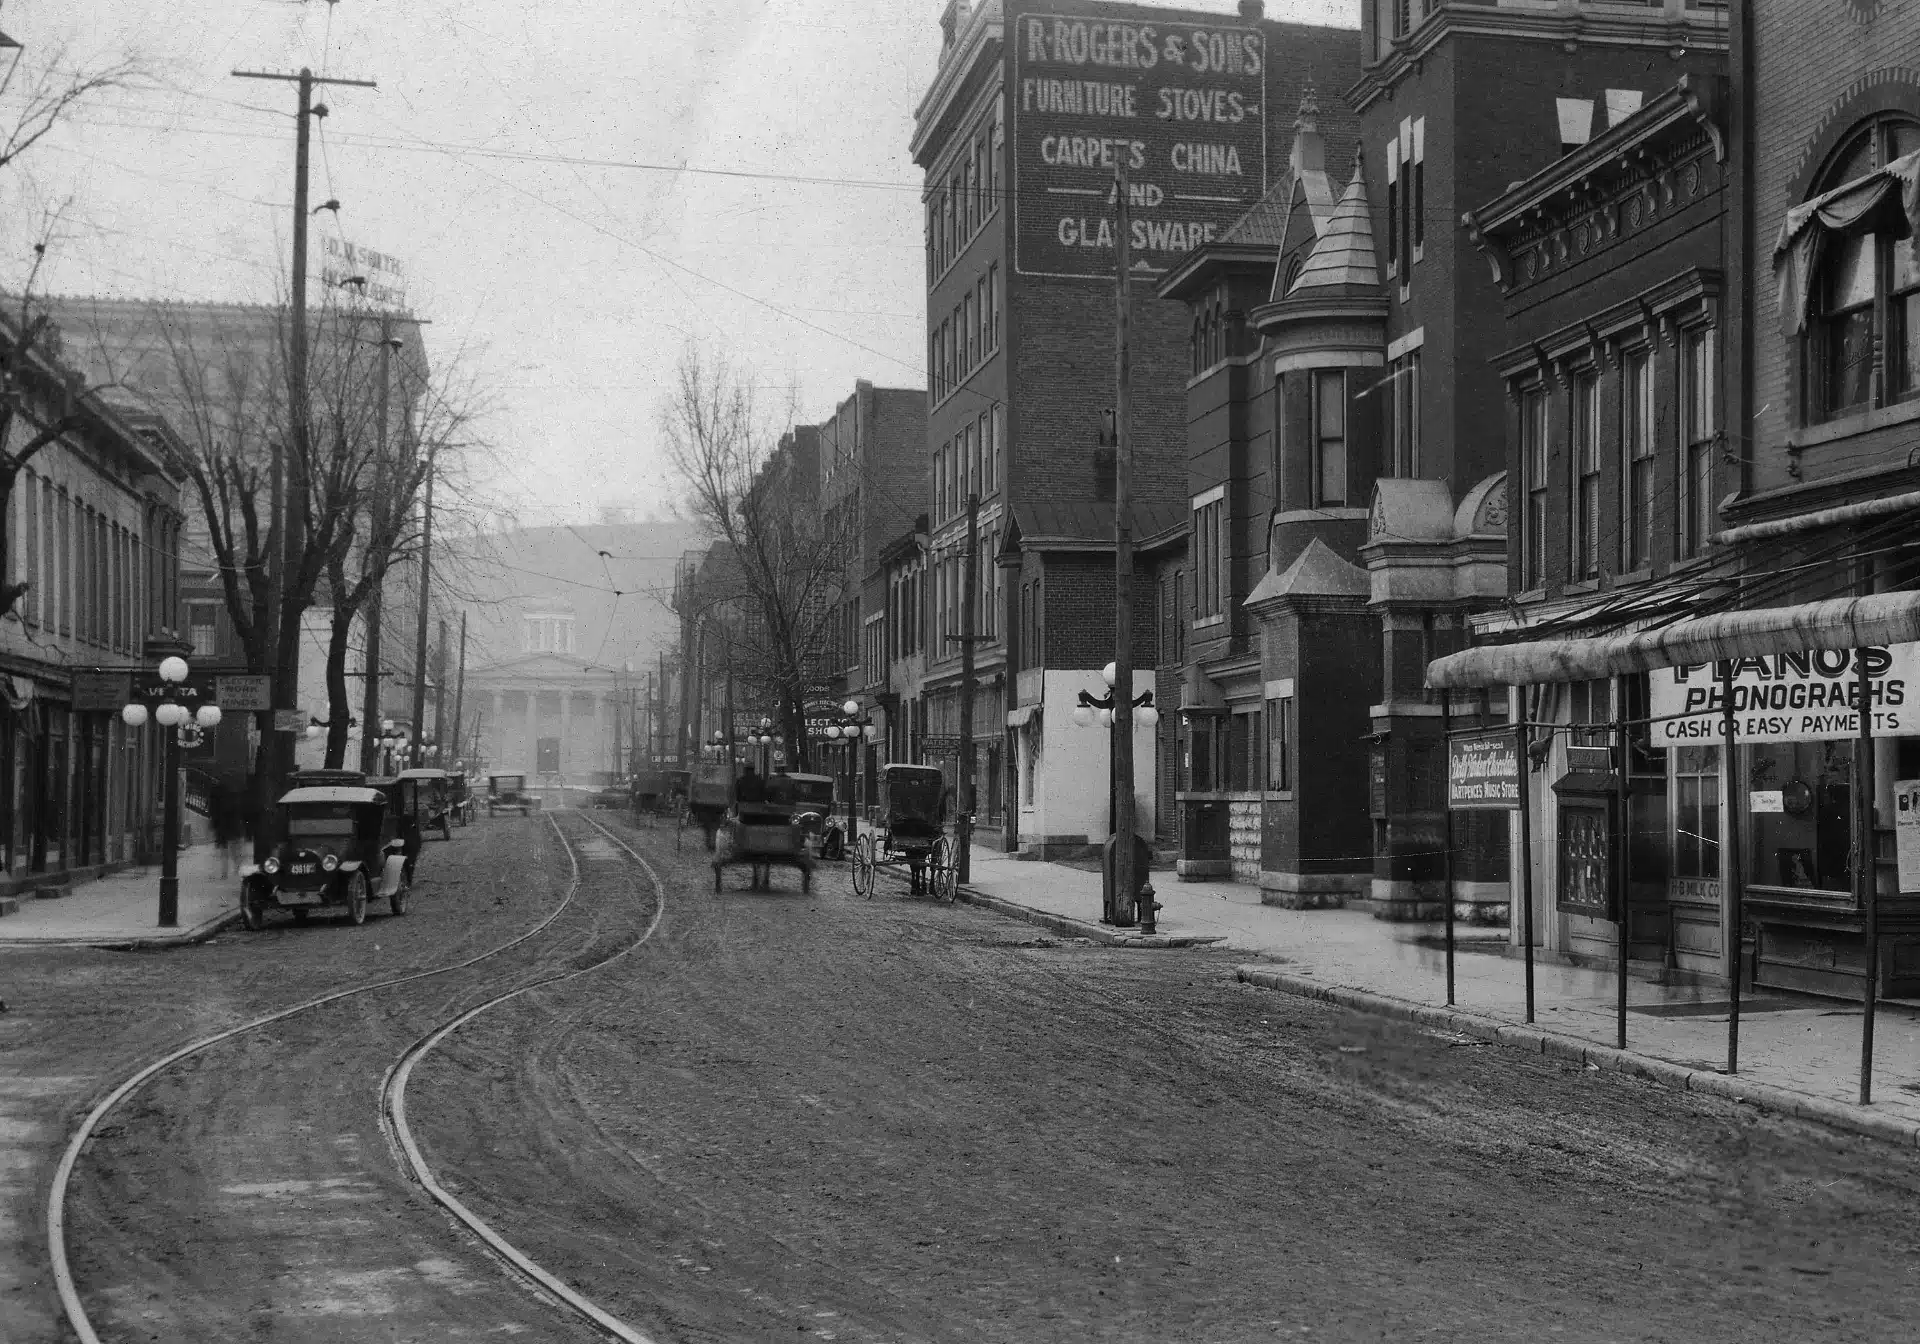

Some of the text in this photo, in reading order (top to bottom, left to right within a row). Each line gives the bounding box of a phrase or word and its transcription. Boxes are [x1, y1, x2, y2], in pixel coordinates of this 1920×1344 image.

[1163, 35, 1186, 65] &
[1191, 31, 1262, 75] SONS
[1023, 78, 1137, 117] FURNITURE
[1171, 143, 1242, 175] CHINA
[1058, 217, 1217, 251] GLASWARE
[1685, 680, 1906, 712] PHONOGRAPHS
[1665, 719, 1712, 739] CASH
[1746, 715, 1793, 735] EASY
[1801, 712, 1900, 733] PAYMETS
